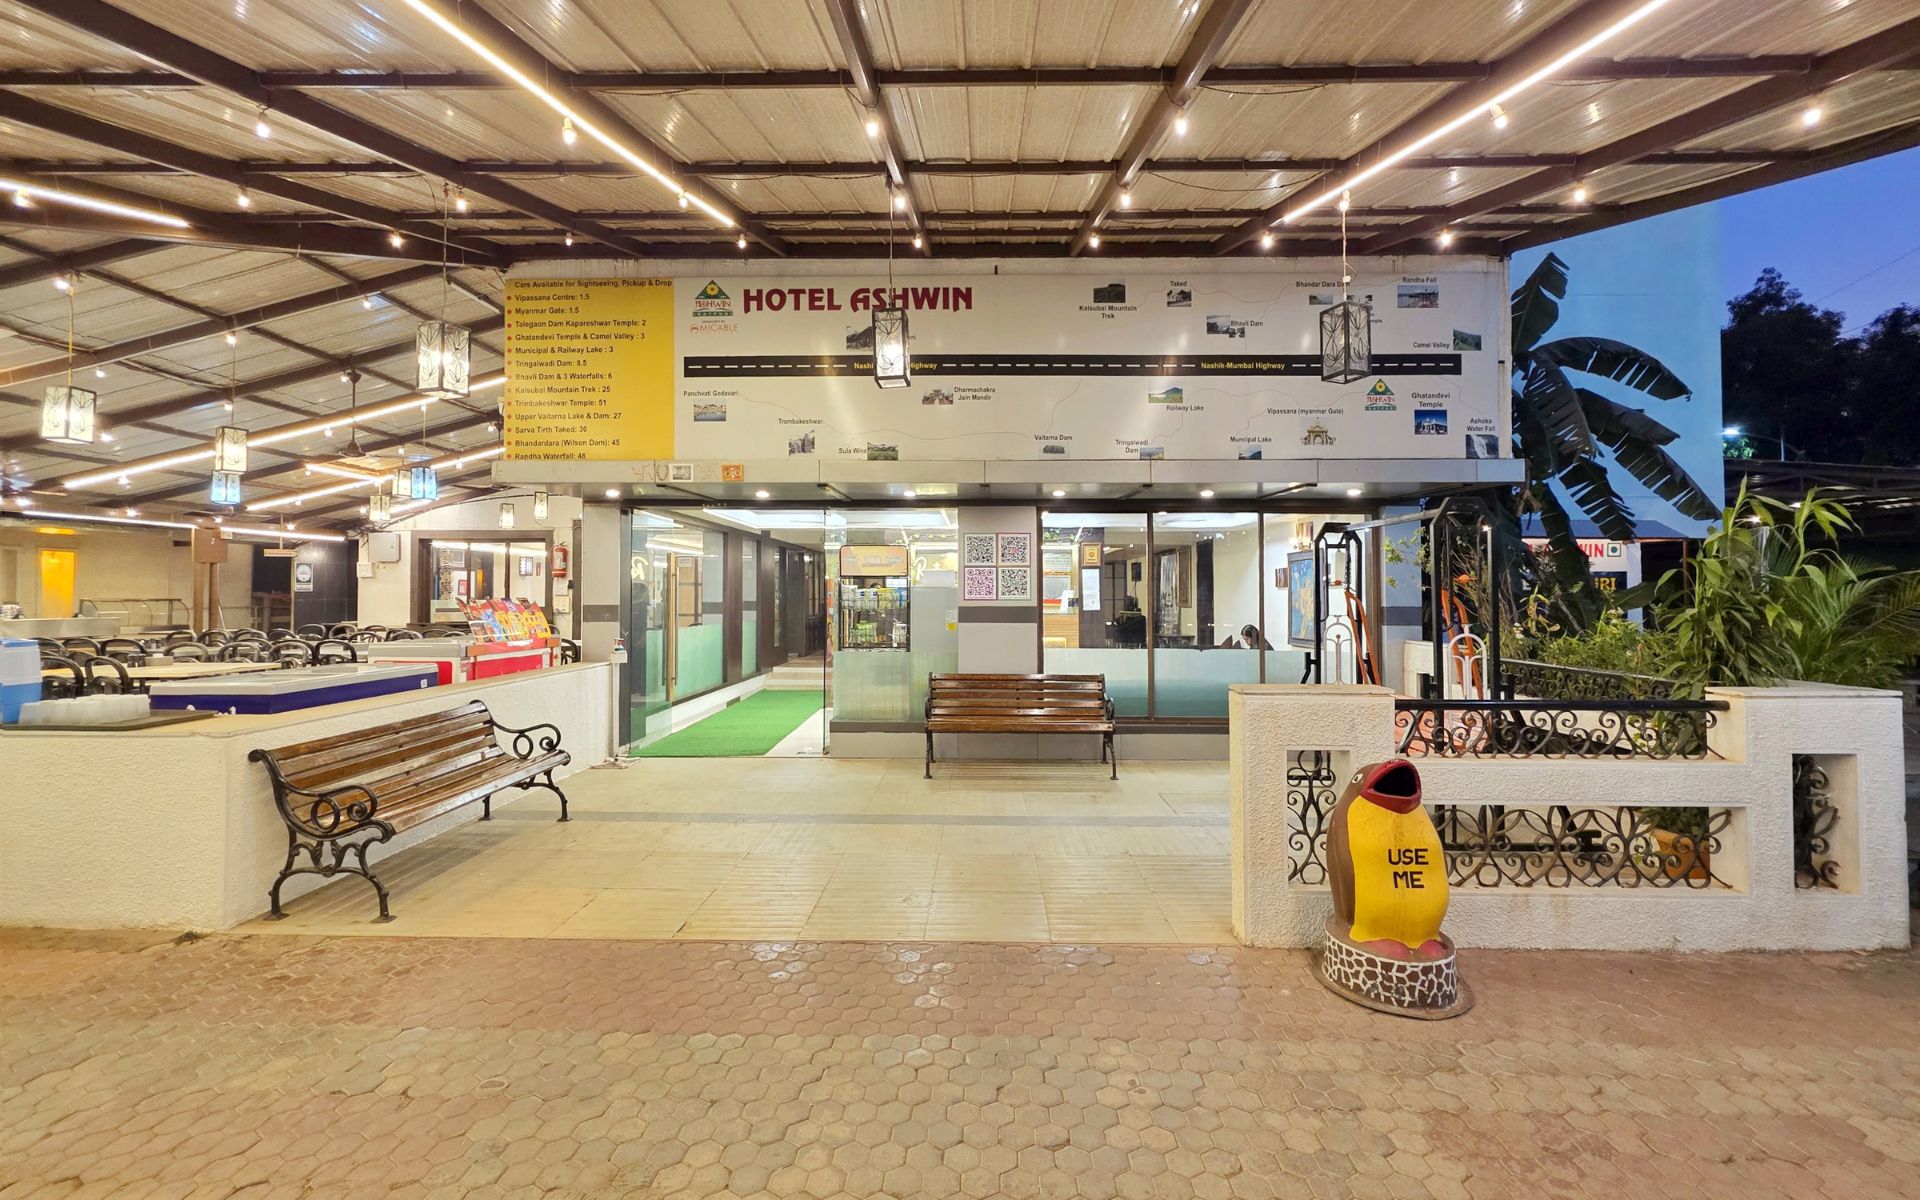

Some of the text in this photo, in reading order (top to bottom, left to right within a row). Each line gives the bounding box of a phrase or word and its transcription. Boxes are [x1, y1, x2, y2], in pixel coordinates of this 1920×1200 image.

[515, 294, 550, 302] Vipassana
[743, 287, 973, 314] HOTEL ASHWIN
[515, 321, 546, 329] Talegaon
[1433, 342, 1450, 350] Valley
[515, 360, 555, 368] Tringalwadi
[1256, 362, 1285, 370] Highway
[1267, 408, 1344, 416] Vipassana (myanmar Gate)
[515, 413, 536, 421] Upper
[561, 439, 587, 447] (Wilson
[1388, 848, 1429, 866] USE
[1393, 870, 1425, 889] ME
